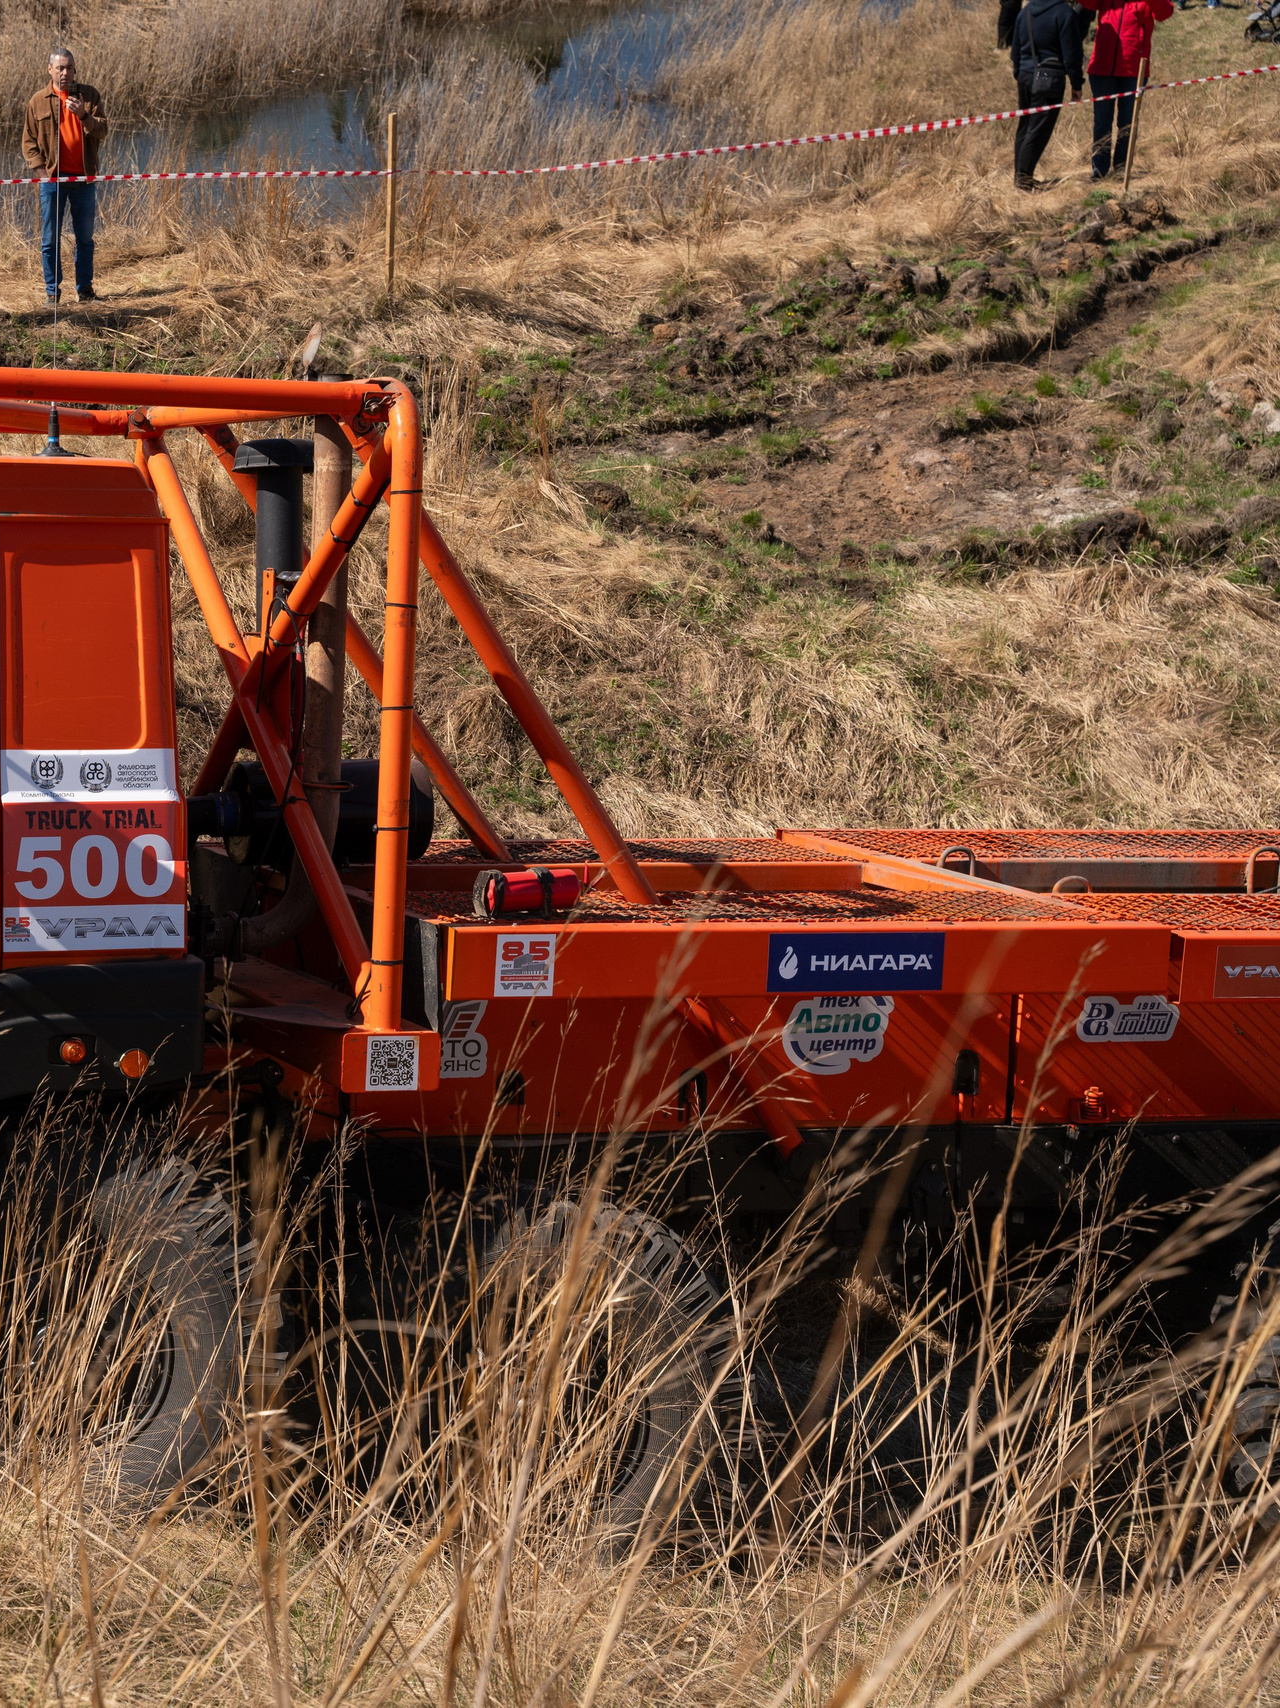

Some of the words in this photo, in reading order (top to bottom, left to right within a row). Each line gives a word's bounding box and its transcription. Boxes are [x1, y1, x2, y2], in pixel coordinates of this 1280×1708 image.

[25, 809, 92, 830] TRUCK
[102, 808, 162, 829] TRIAL
[14, 833, 175, 900] 500
[5, 917, 30, 928] 85
[36, 915, 180, 939] УРАЛ
[502, 941, 550, 961] 85
[1223, 965, 1280, 978] УРА
[500, 982, 548, 990] УРАЛ
[790, 1008, 882, 1034] Авто
[441, 1039, 481, 1057] ТО
[809, 1038, 877, 1054] центр
[440, 1060, 481, 1071] ЯНС
